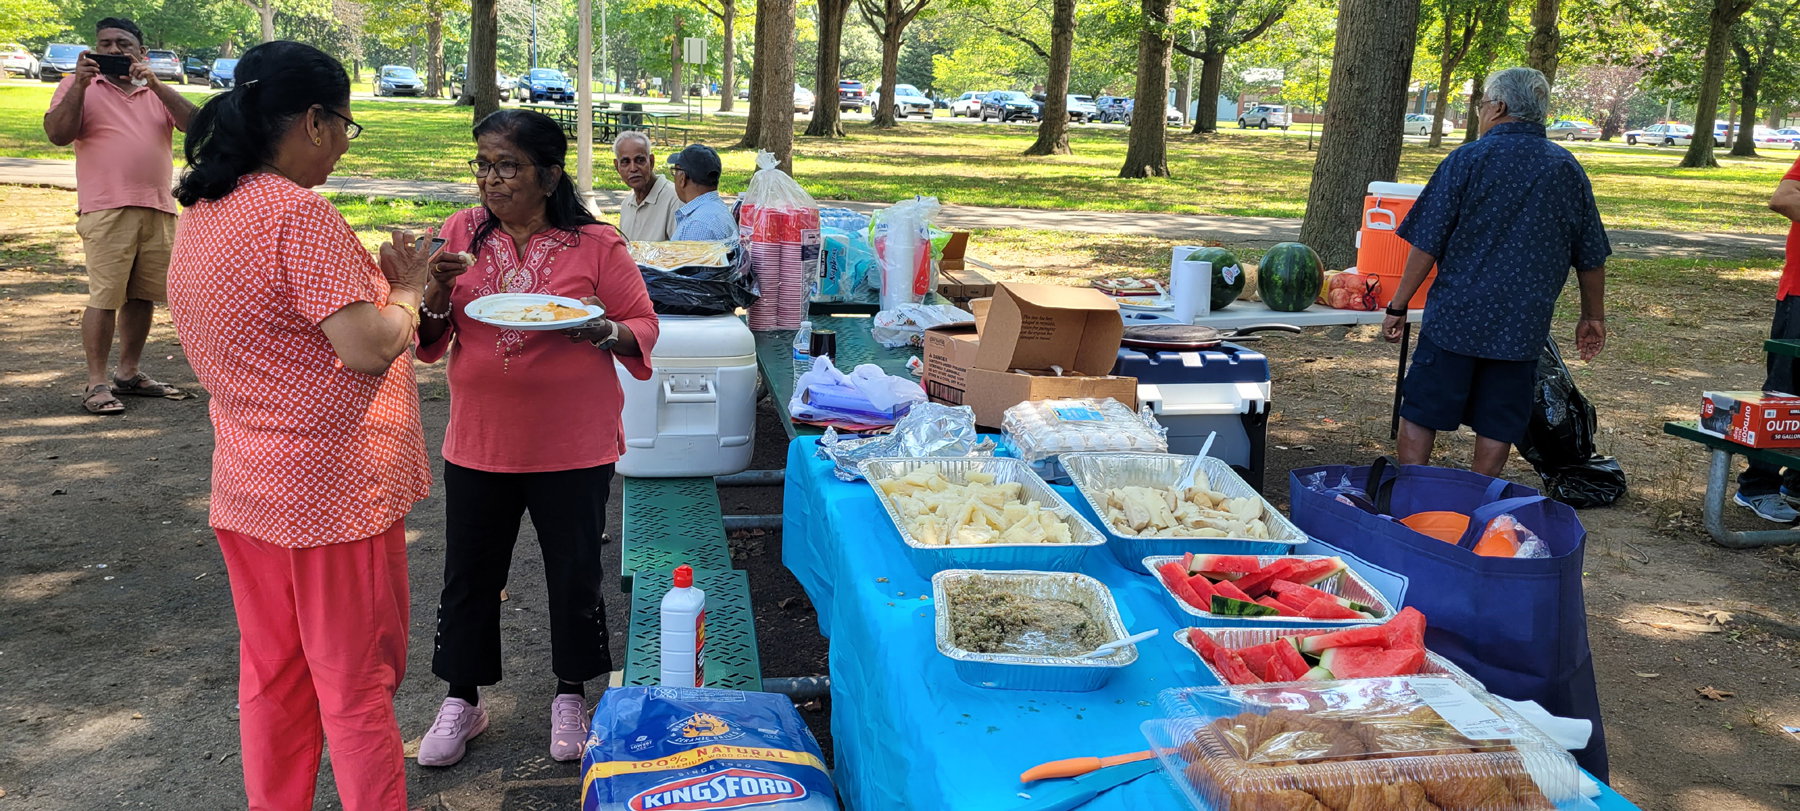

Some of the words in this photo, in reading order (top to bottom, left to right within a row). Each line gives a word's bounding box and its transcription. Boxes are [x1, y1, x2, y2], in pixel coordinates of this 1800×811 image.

[1741, 405, 1752, 443] OUTDOOR
[1766, 420, 1800, 431] OUTD
[631, 755, 688, 769] 100%
[696, 745, 789, 759] NATURAL
[678, 764, 716, 777] SINCE
[644, 775, 793, 809] KINGSFORD
